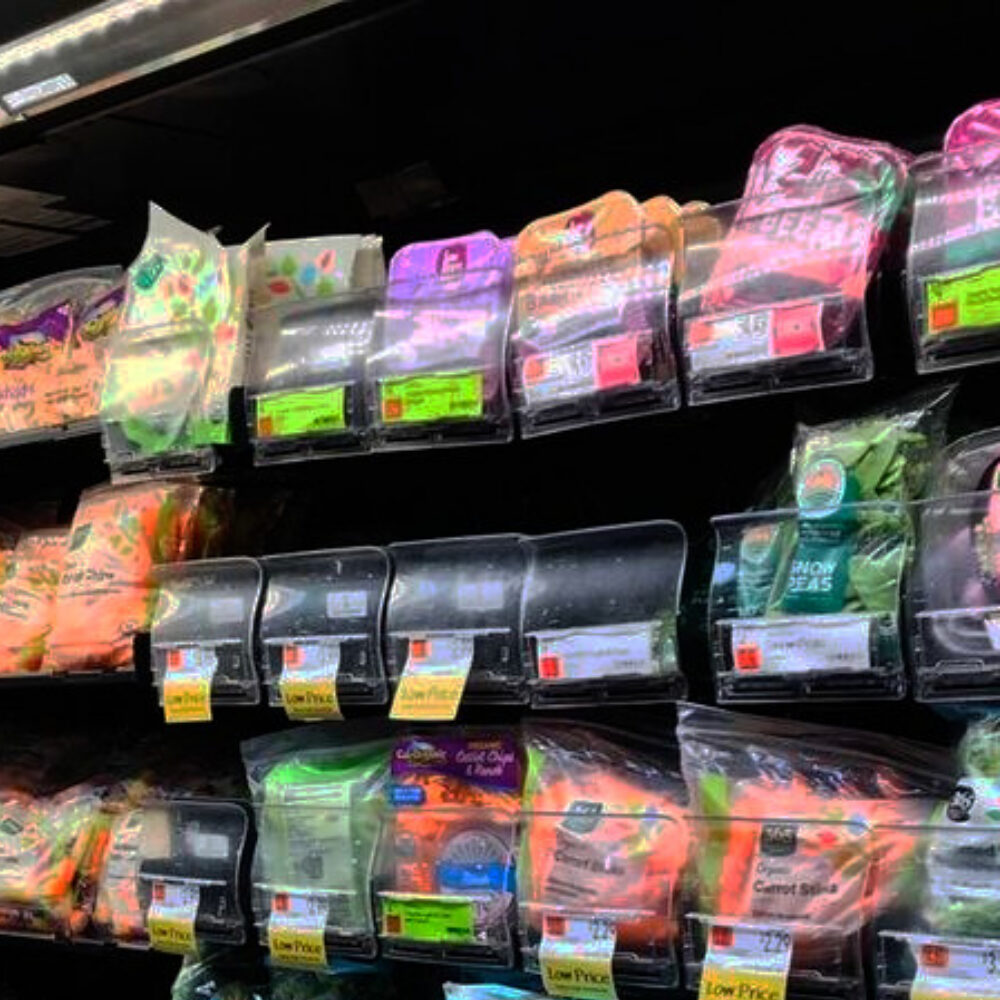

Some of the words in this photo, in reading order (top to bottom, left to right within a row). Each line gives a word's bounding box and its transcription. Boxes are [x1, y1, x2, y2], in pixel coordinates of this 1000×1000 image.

[753, 880, 796, 895] Carrot
[273, 939, 292, 951] Low
[293, 939, 322, 953] Price
[548, 966, 571, 980] Low
[573, 968, 610, 983] Price
[706, 981, 735, 996] Low
[737, 982, 779, 1000] Price
